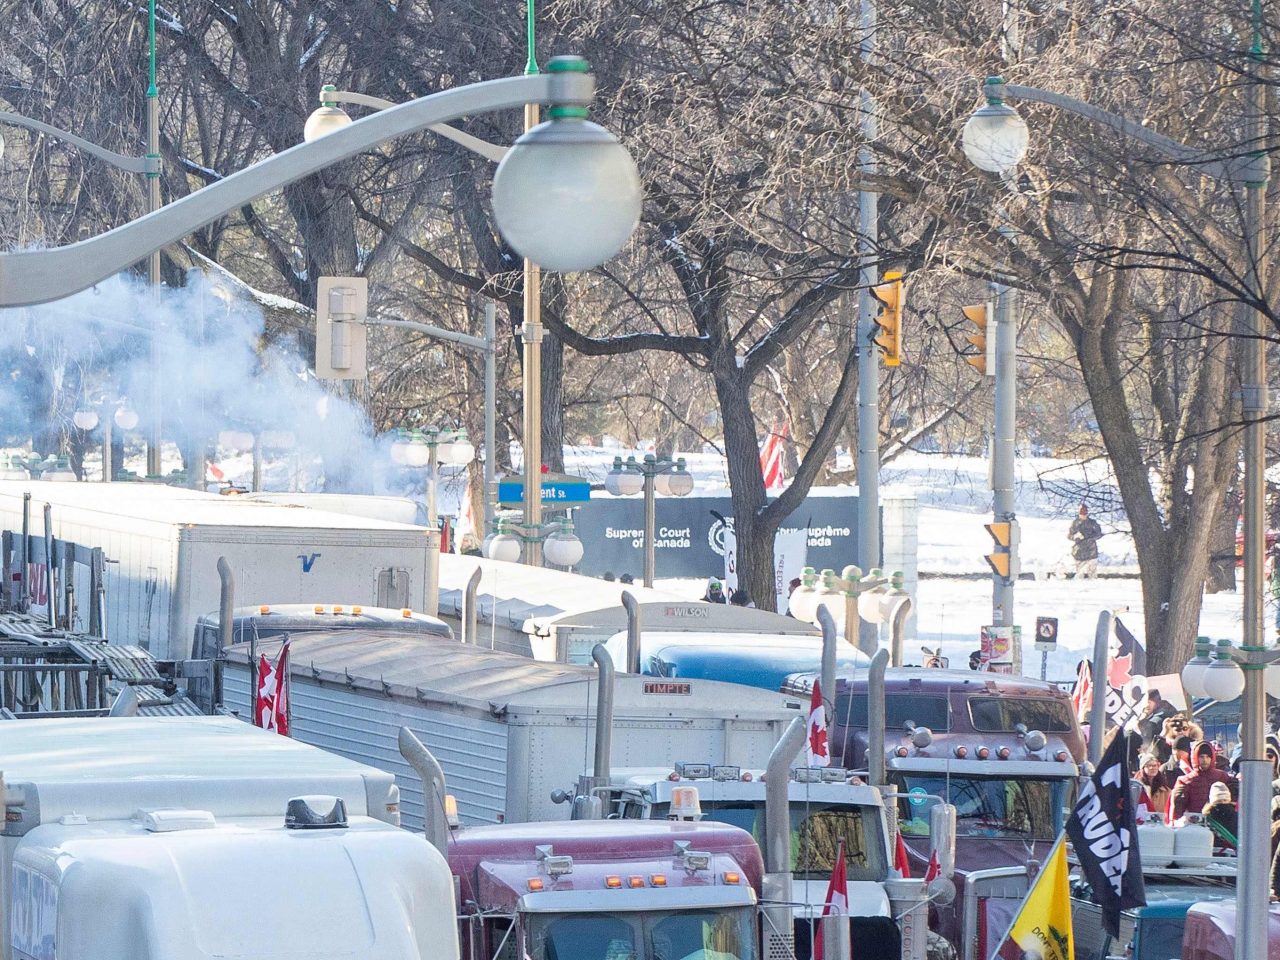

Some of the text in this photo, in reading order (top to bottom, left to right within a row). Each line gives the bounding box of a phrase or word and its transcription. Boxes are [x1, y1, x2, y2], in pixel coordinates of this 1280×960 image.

[660, 527, 690, 538] Court
[808, 525, 851, 538] uprême
[632, 539, 644, 548] of
[673, 607, 709, 617] WILSON
[645, 683, 689, 694] TIMPTE
